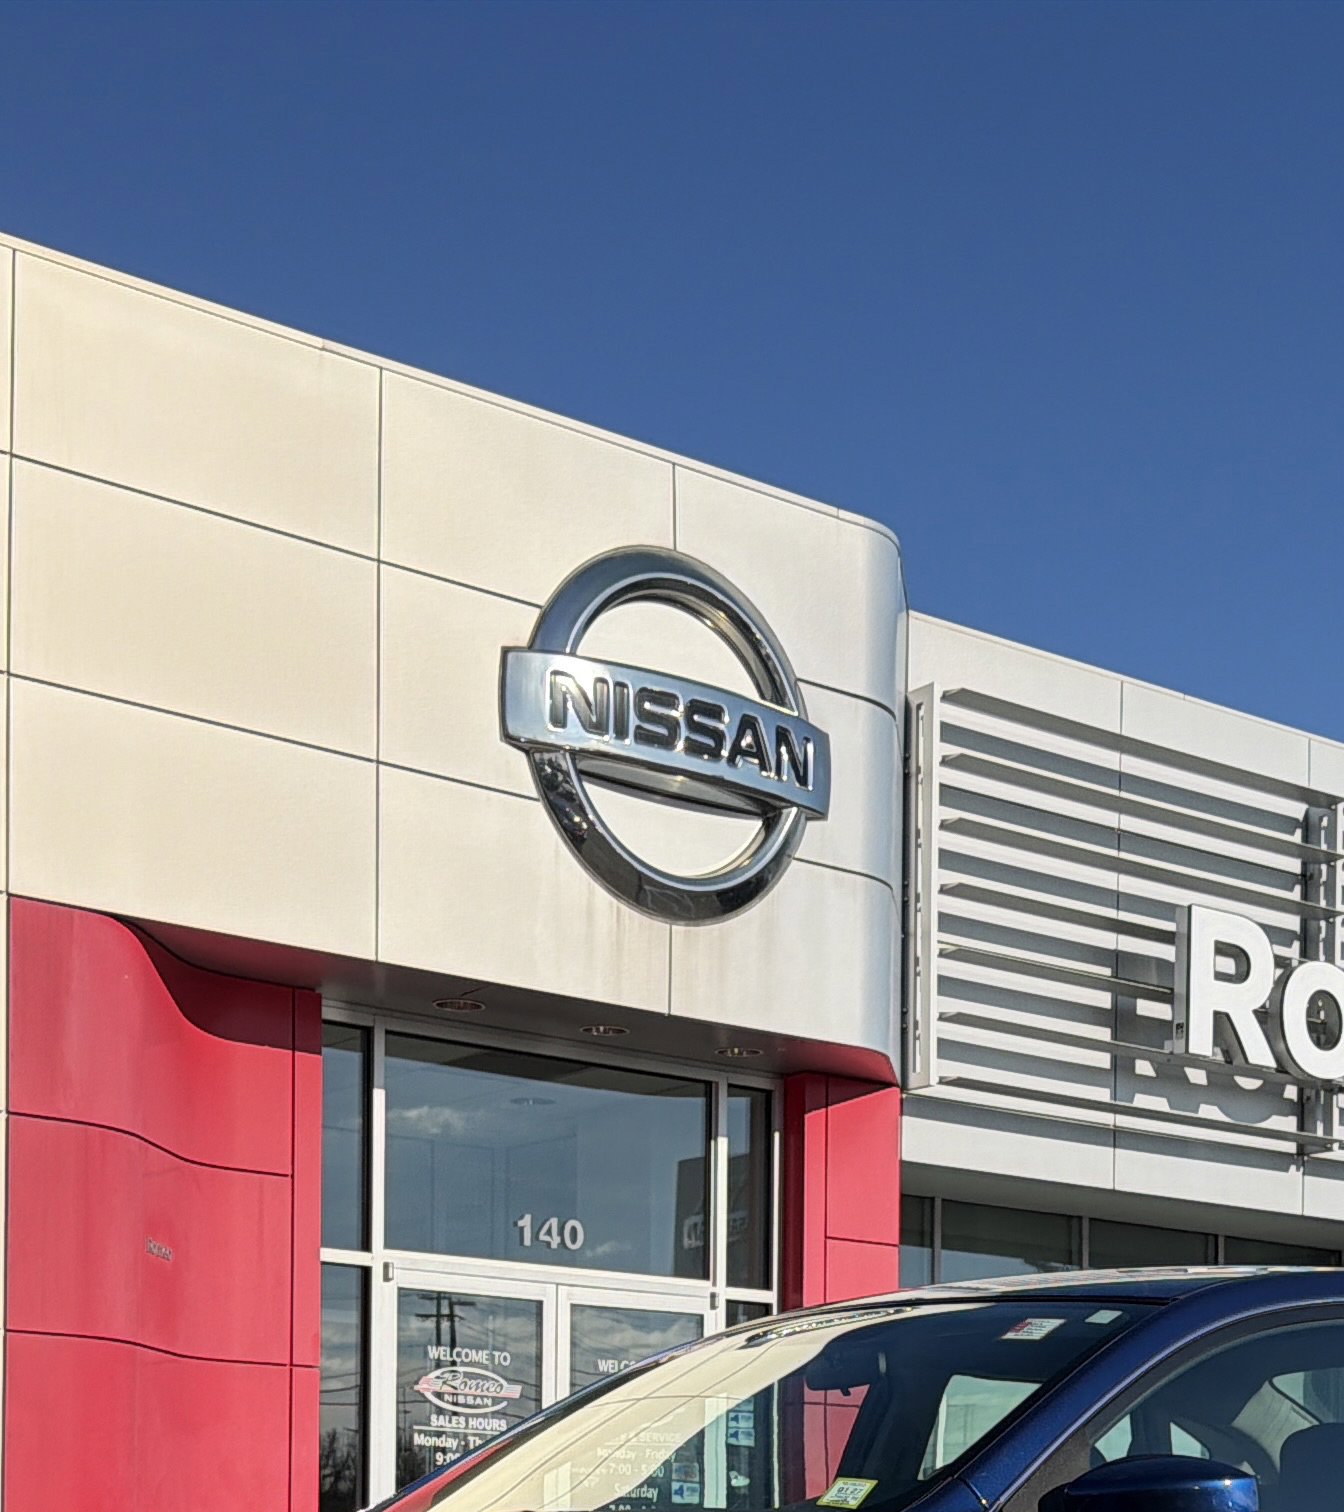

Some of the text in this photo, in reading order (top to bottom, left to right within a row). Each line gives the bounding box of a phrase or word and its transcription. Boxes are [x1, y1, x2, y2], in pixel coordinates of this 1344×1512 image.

[547, 668, 814, 791] NISSAN
[517, 1213, 585, 1250] 140
[427, 1345, 511, 1366] WELCOME TO
[435, 1369, 504, 1395] Romeo
[443, 1393, 493, 1407] NISSAN
[430, 1413, 507, 1432] SALES HOURS
[413, 1432, 459, 1451] Monday
[467, 1435, 484, 1449] Th
[614, 1482, 659, 1503] Surday
